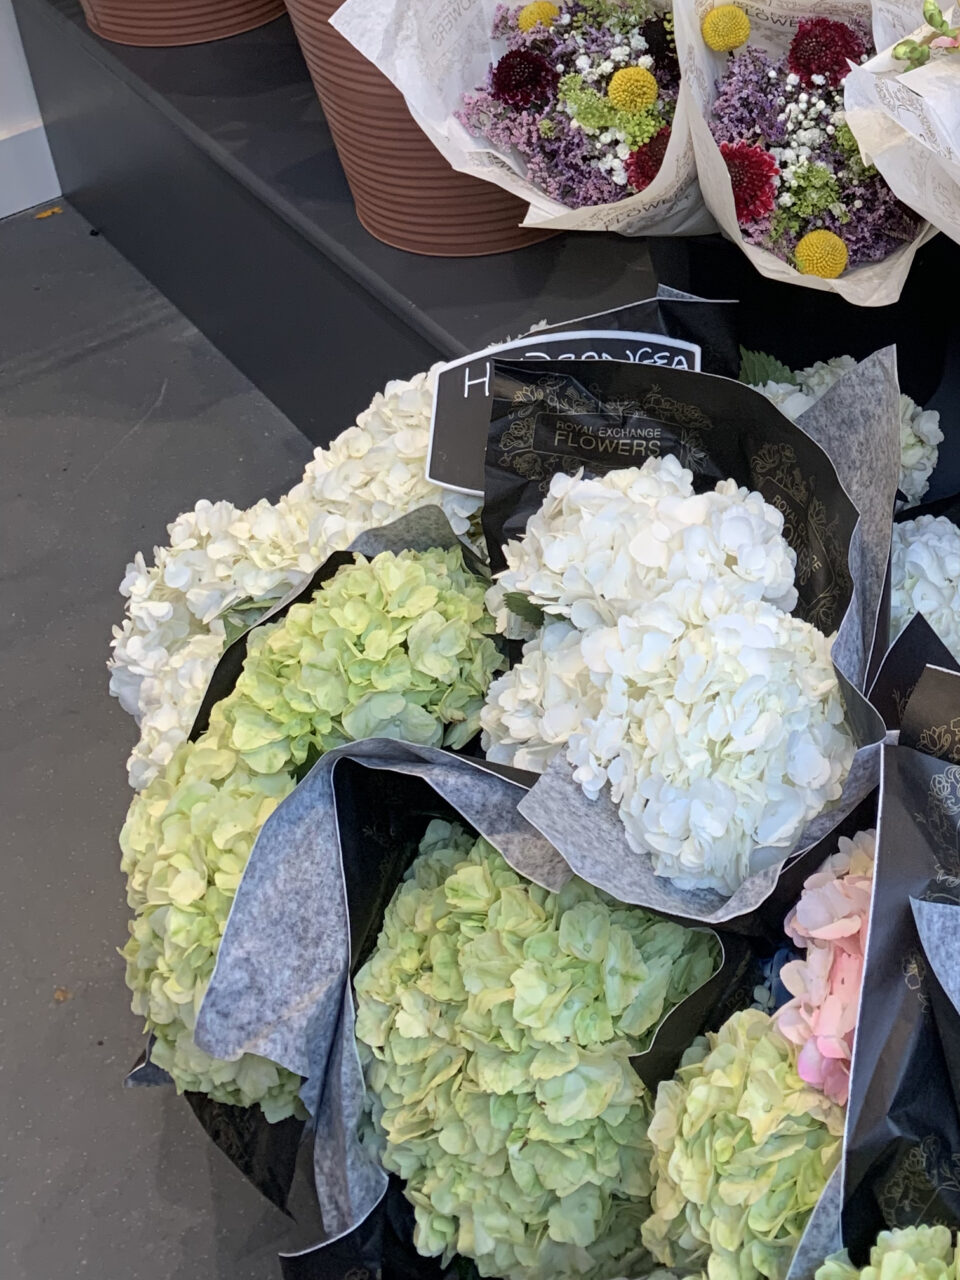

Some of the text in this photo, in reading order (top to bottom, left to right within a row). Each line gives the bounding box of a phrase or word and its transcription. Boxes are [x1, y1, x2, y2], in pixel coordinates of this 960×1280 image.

[741, 6, 800, 29] LOWE
[556, 421, 662, 439] ROYAL EXCHANGE
[554, 431, 662, 458] FLOWERS
[772, 494, 798, 527] ROYAL
